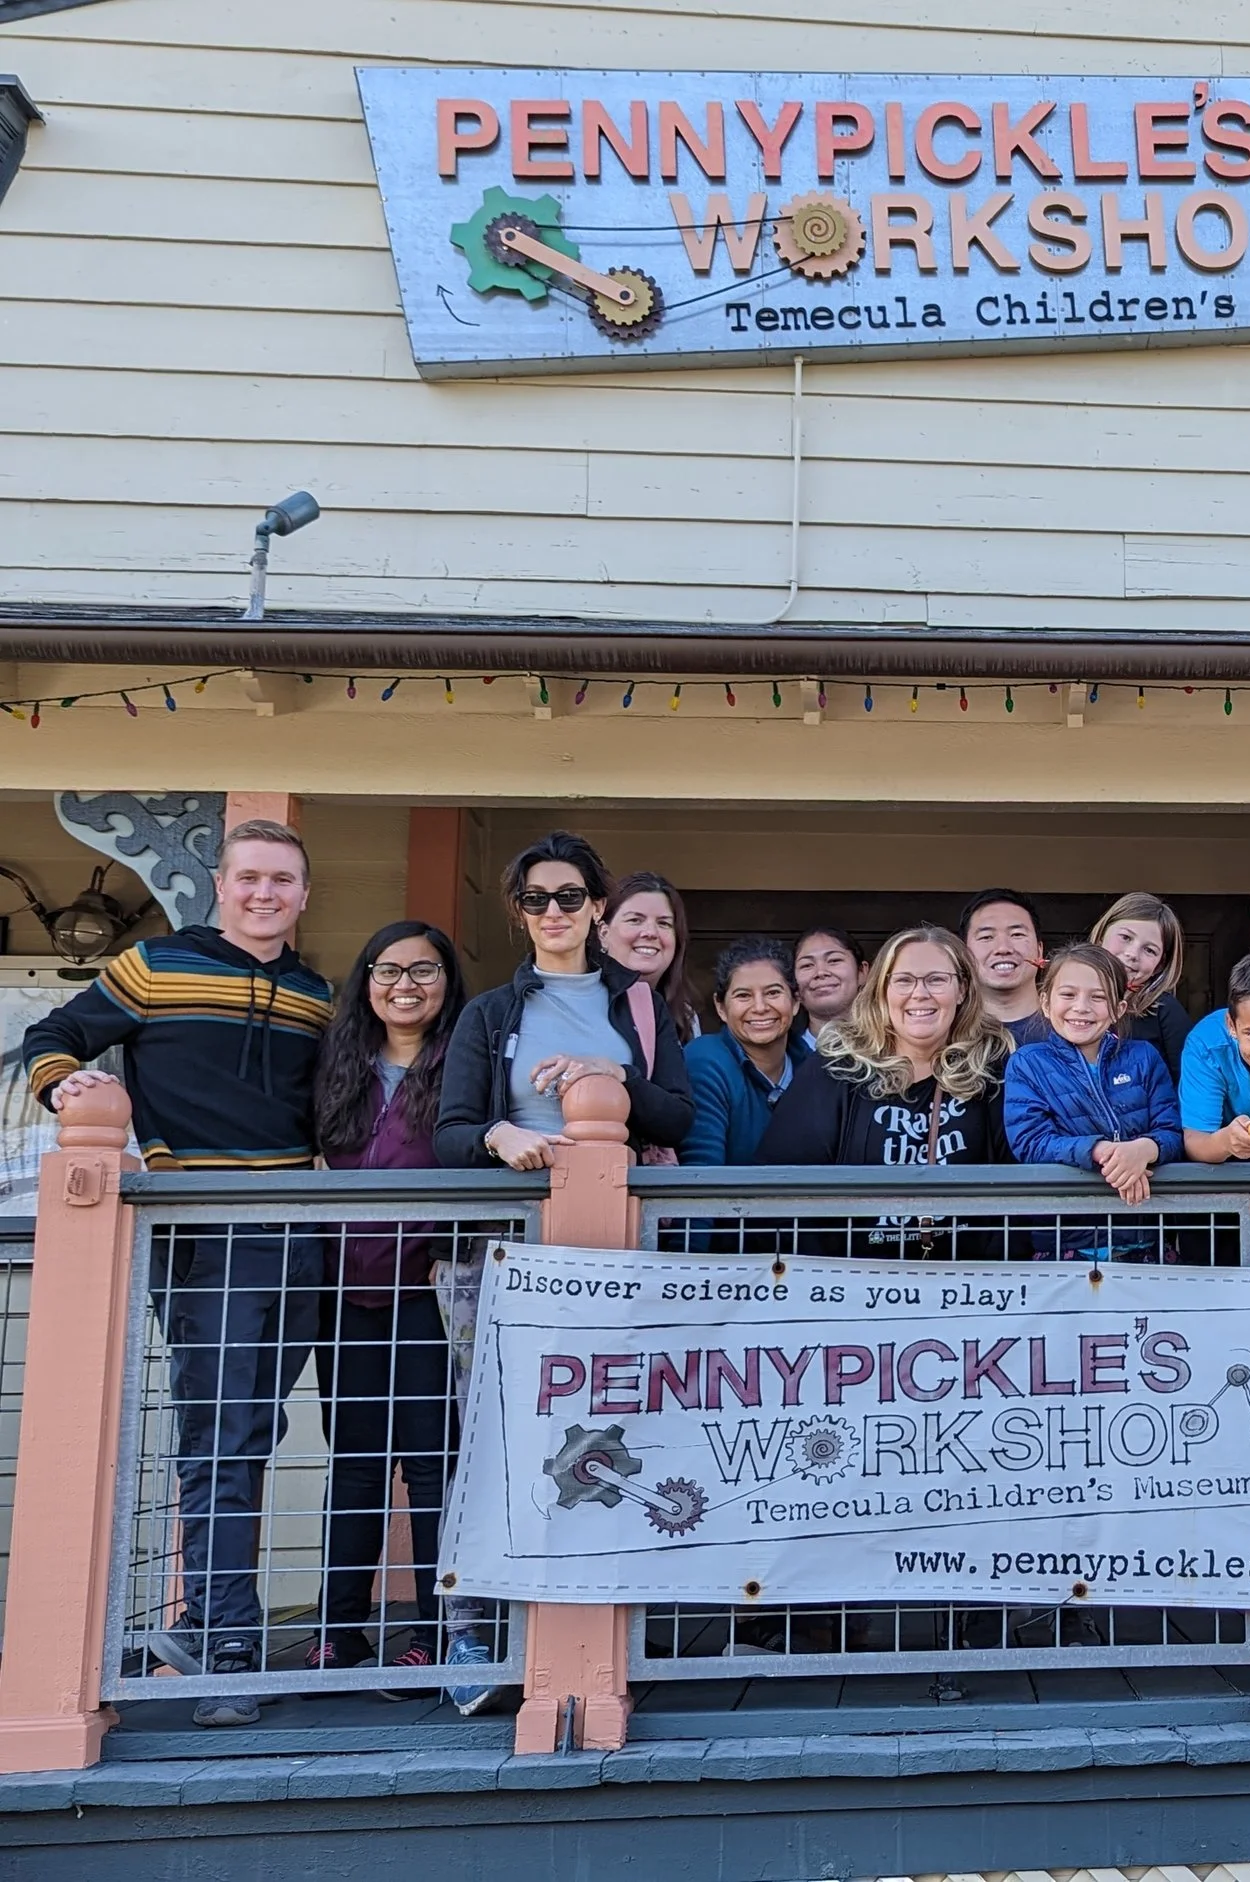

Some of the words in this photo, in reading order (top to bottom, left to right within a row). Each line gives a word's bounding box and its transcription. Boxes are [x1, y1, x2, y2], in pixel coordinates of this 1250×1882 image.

[725, 297, 945, 332] Temecula
[976, 288, 1235, 326] Children's
[506, 1268, 641, 1299] Discover
[662, 1279, 788, 1301] science
[810, 1284, 845, 1303] as
[866, 1286, 920, 1308] you
[941, 1284, 1028, 1309] play!
[536, 1316, 1192, 1415] PENNYPICKLE'S
[701, 1403, 1220, 1485] WORKSHOP
[747, 1491, 913, 1524] Temecula
[924, 1478, 1113, 1512] Children's
